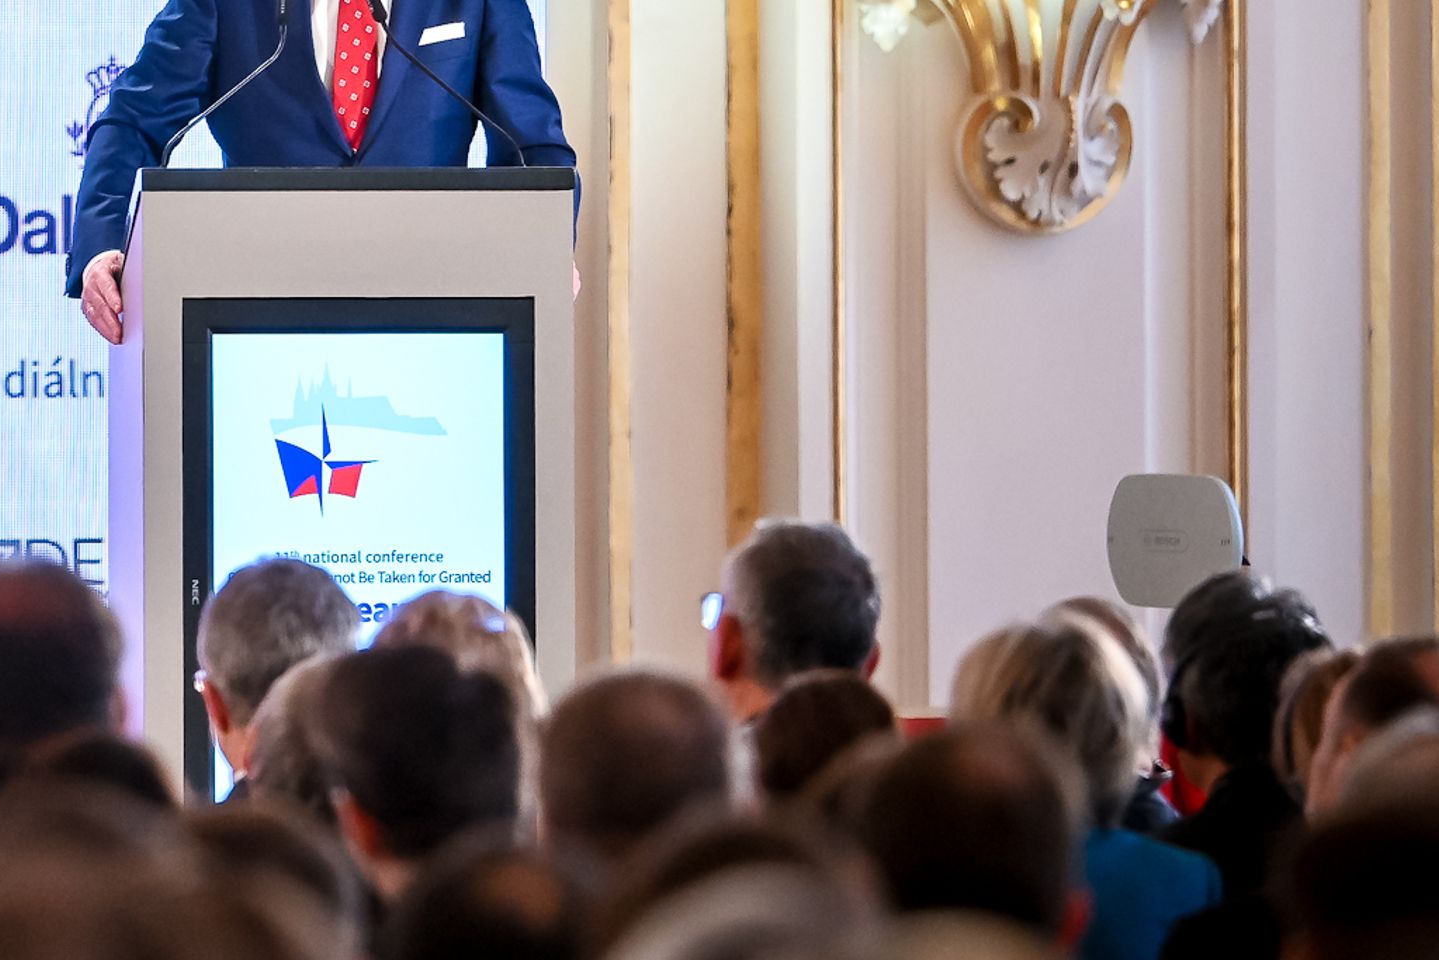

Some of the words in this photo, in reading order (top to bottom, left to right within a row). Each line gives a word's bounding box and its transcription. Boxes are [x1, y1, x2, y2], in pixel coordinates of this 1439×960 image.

[303, 549, 362, 564] national
[366, 550, 444, 564] conference
[359, 570, 376, 584] Be
[377, 570, 416, 584] Taken
[418, 570, 437, 584] for
[438, 570, 492, 584] Granted
[191, 579, 200, 606] NEC
